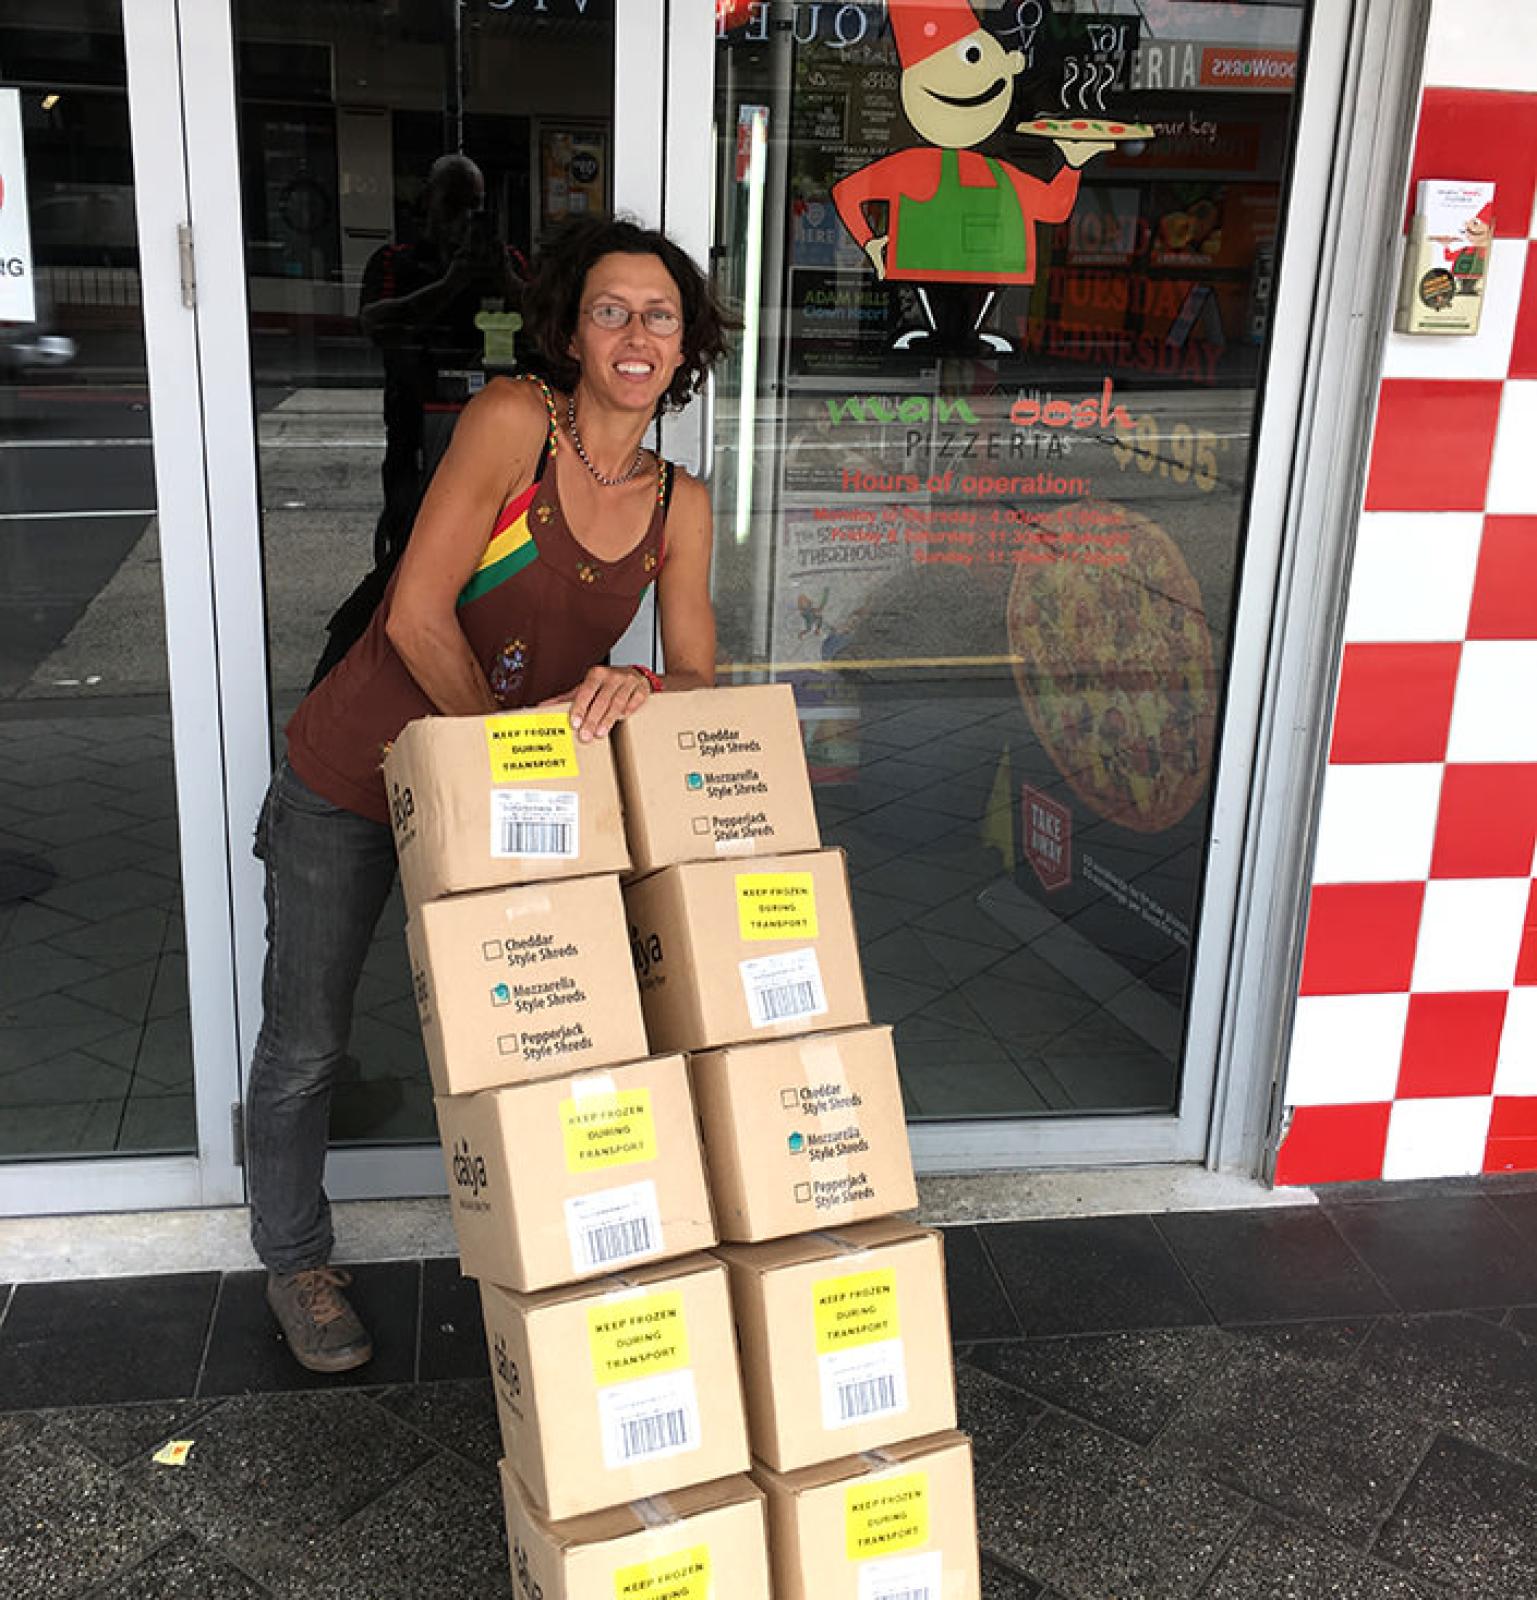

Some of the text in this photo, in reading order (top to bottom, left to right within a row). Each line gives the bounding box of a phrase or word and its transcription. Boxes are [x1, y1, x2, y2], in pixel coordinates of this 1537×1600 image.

[906, 431, 1065, 459] PIZZERIA
[842, 468, 920, 493] Hours
[926, 470, 953, 493] of
[961, 472, 1092, 498] operation:
[524, 727, 566, 738] FROZEN
[697, 729, 740, 743] Cheddar
[511, 743, 553, 754] DURING
[699, 740, 762, 758] Style Shreds
[502, 758, 567, 771] TRANSPORT
[703, 769, 760, 784] Mozzarella
[706, 781, 769, 800] Style Shreds
[712, 812, 767, 829] Pepperjack
[714, 823, 775, 842] Style Shreds
[769, 887, 808, 896] FROZEN
[758, 903, 796, 913] DURING
[750, 918, 808, 929] TRANSPORT
[505, 933, 554, 951] Cheddar
[507, 943, 579, 968] Style Shreds
[512, 976, 576, 997] Mozzarella
[514, 989, 587, 1014] Style Shreds
[520, 1022, 585, 1044] Pepperjack
[522, 1037, 593, 1061] Style Shreds
[799, 1083, 841, 1099] Cheddar
[600, 1105, 644, 1120] FROZEN
[801, 1093, 862, 1116] Style Shreds
[587, 1125, 631, 1141] DURING
[806, 1126, 860, 1146] Mozzarella
[579, 1141, 645, 1160] TRANSPORT
[808, 1138, 869, 1162] Style Shreds
[812, 1171, 868, 1194] Pepperjack
[814, 1186, 875, 1210] Style Shreds
[819, 1285, 891, 1306] KEEP FROZEN
[594, 1308, 677, 1334] KEEP FROZEN
[836, 1304, 877, 1321] DURING
[616, 1329, 663, 1348] DURING
[826, 1320, 889, 1340] TRANSPORT
[606, 1346, 676, 1370] TRANSPORT
[851, 1490, 922, 1512] KEEP FROZEN
[867, 1511, 908, 1528] DURING
[857, 1525, 919, 1548] TRANSPORT
[623, 1562, 705, 1594] KEEP FROZEN
